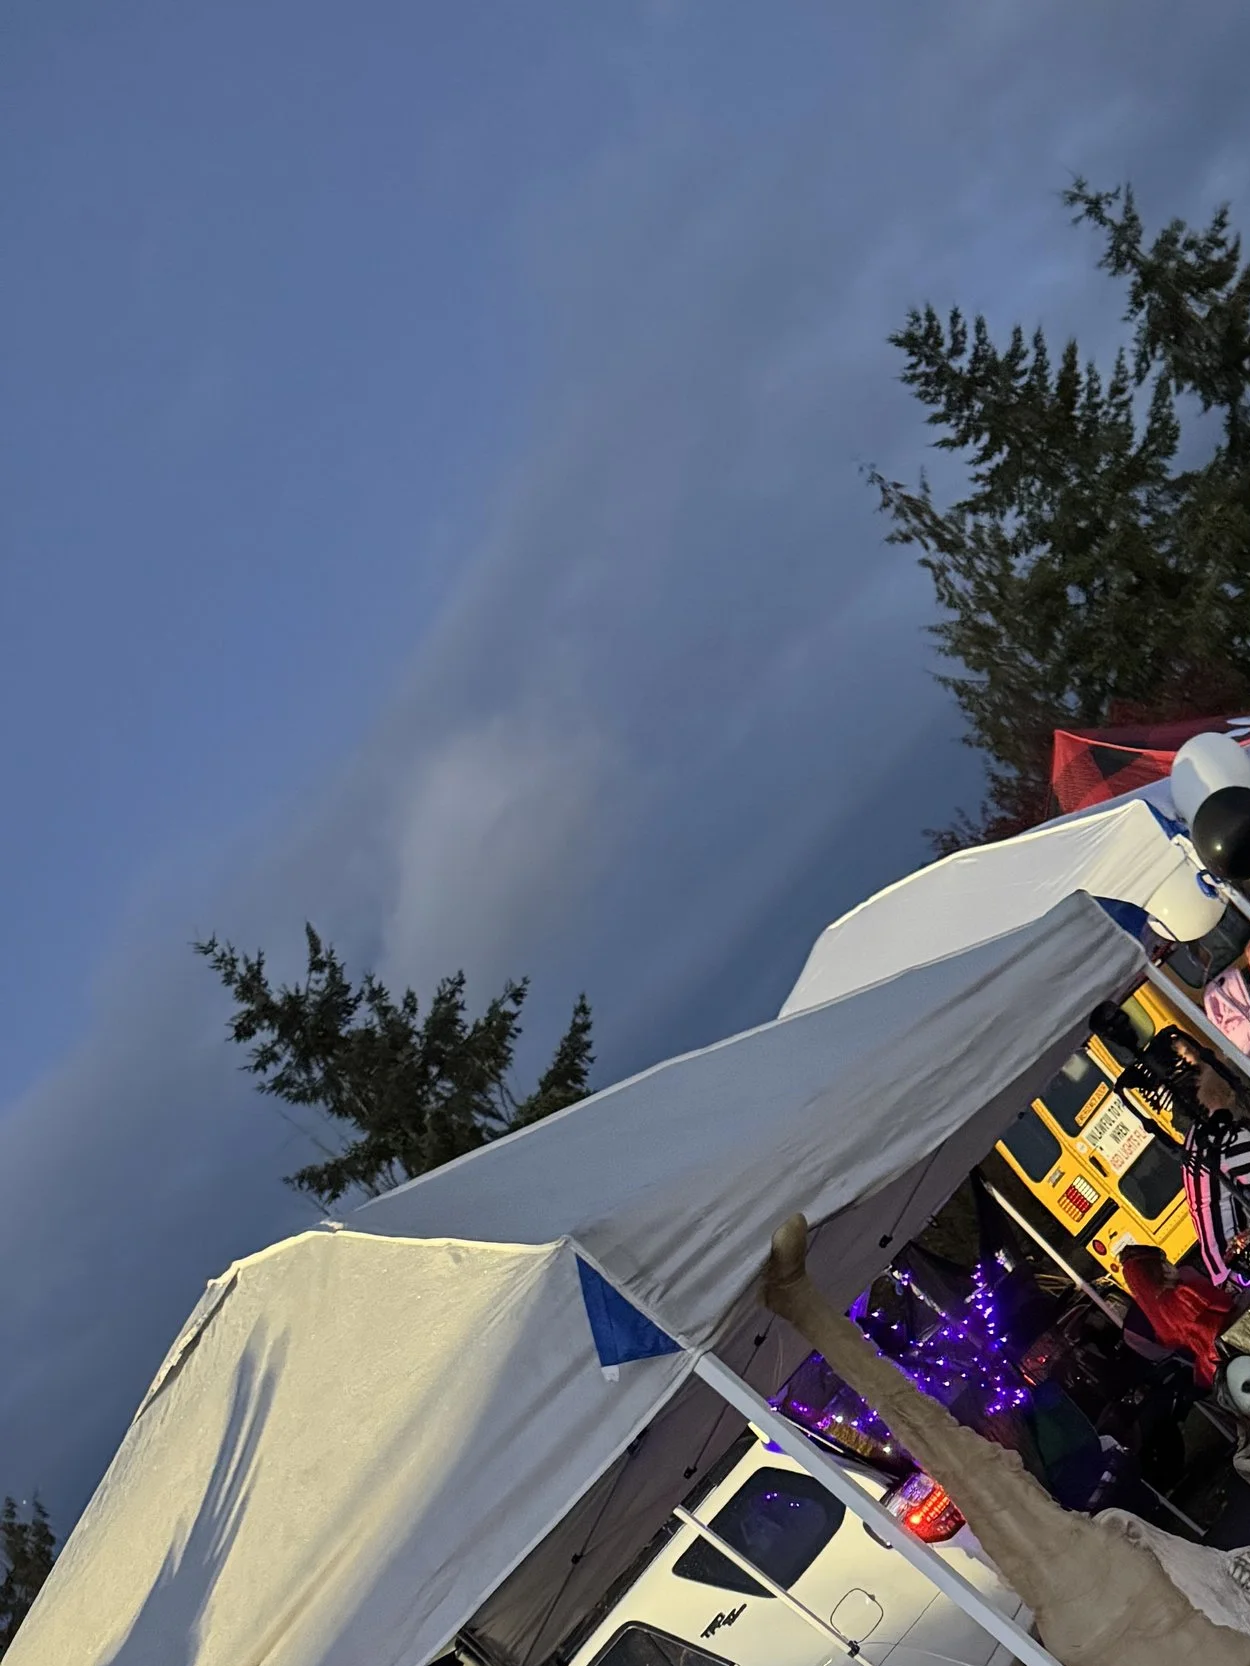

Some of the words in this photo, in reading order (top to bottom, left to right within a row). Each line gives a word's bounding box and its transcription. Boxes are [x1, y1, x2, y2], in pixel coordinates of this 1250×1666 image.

[1085, 1112, 1115, 1146] UNLAWFUL
[1108, 1105, 1121, 1119] TO
[1109, 1122, 1130, 1144] WHEN
[1110, 1153, 1125, 1170] RED
[1118, 1134, 1141, 1160] LIGHTS
